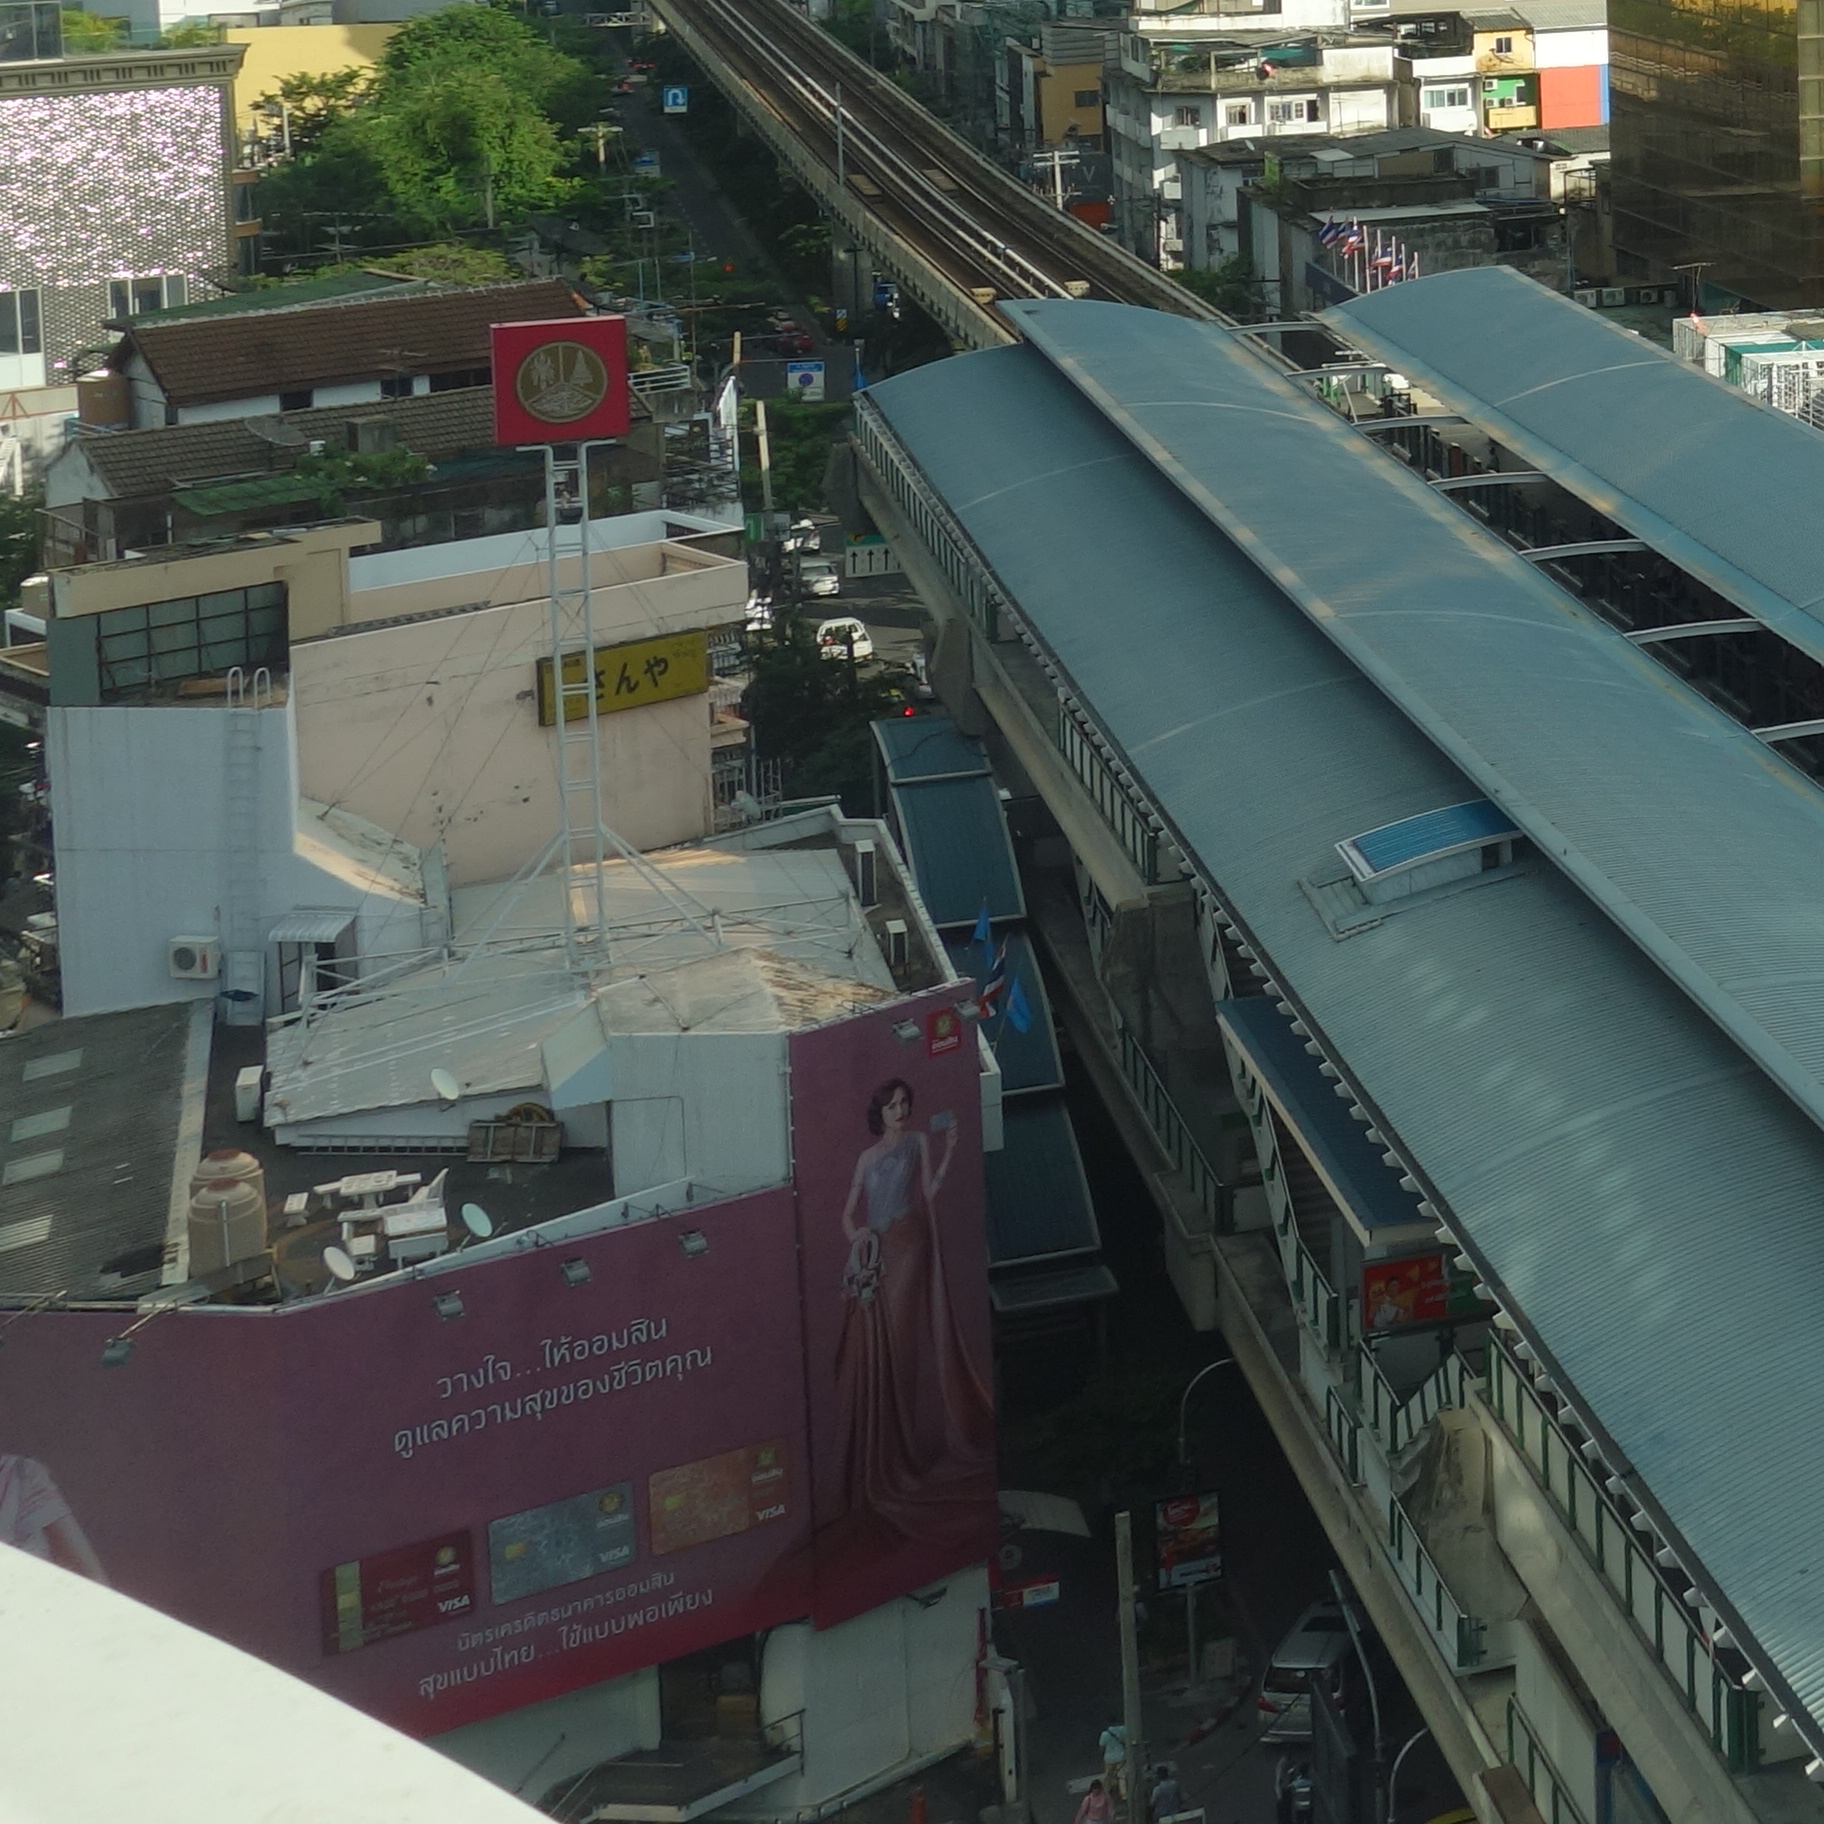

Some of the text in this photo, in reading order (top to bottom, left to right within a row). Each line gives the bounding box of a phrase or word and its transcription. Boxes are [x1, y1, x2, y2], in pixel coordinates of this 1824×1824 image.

[393, 1344, 713, 1460] ดูแลความสุขของชีวิตคุณ
[756, 1504, 787, 1522] VISA
[599, 1545, 630, 1564] VISA
[437, 1594, 471, 1614] VISA
